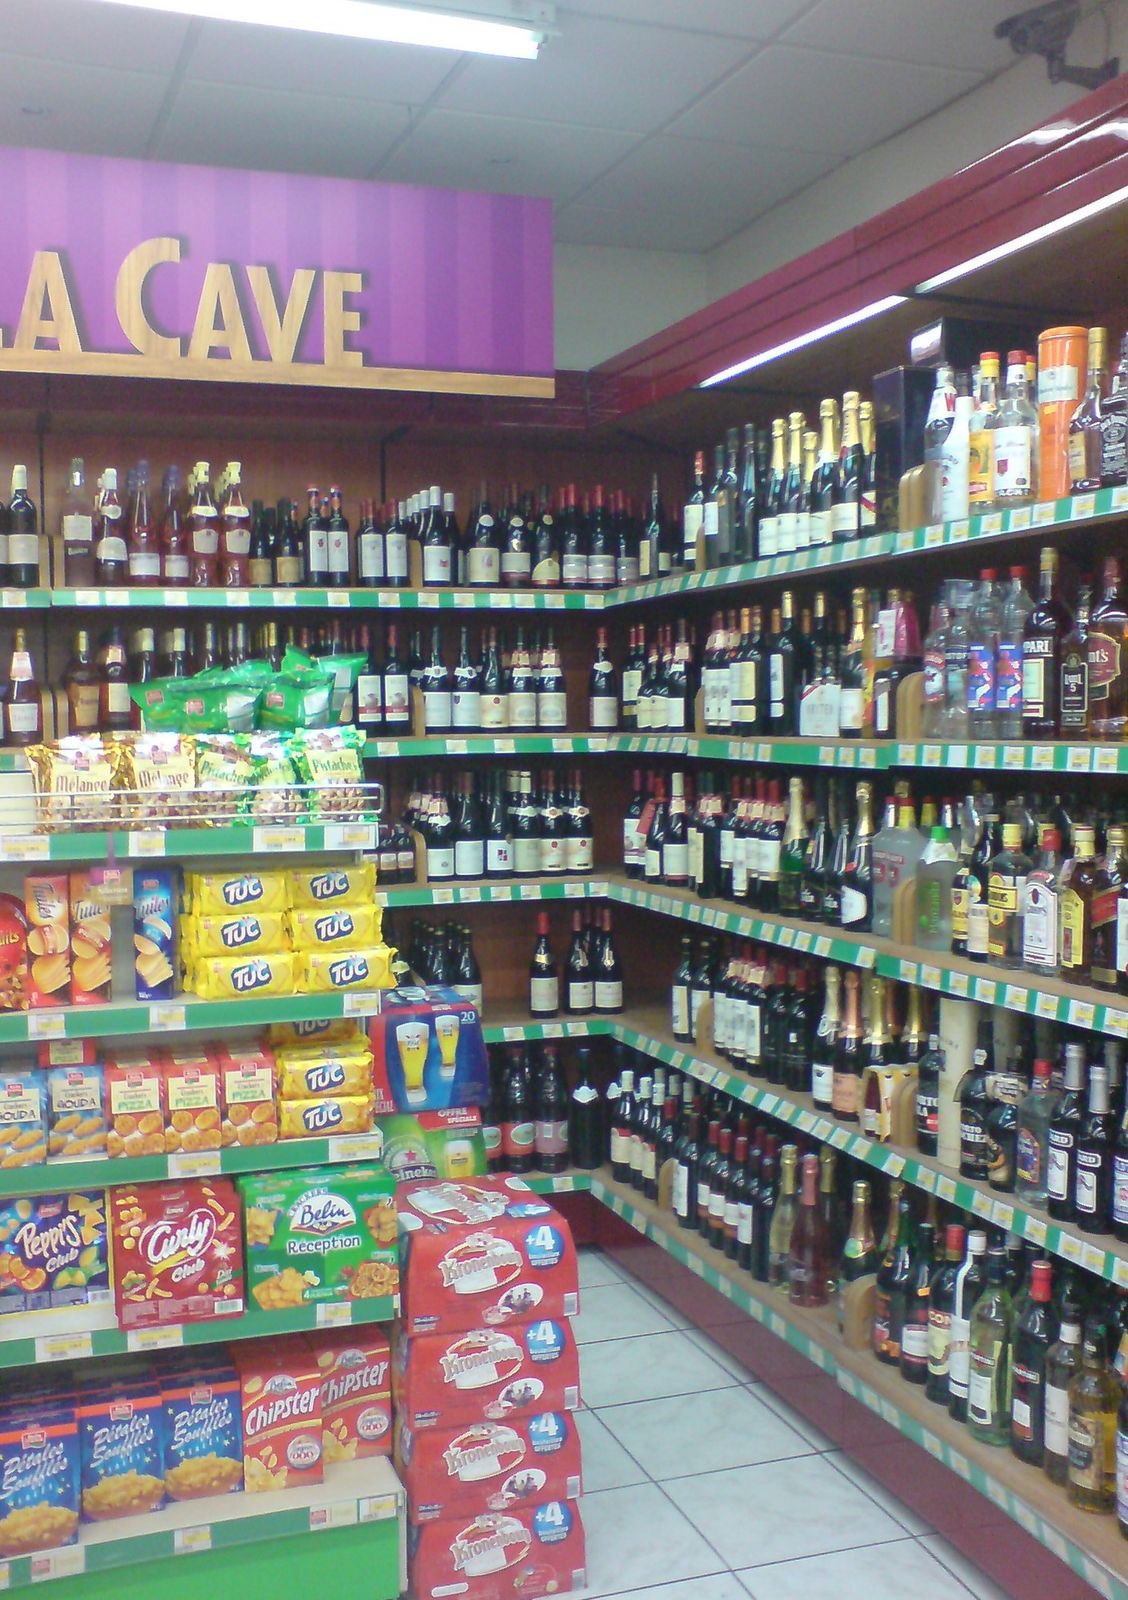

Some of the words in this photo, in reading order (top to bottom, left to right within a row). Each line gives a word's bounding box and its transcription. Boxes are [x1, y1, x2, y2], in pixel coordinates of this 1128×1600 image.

[0, 251, 82, 352] A
[115, 236, 363, 367] CAVE
[1023, 639, 1049, 653] PARI
[1070, 683, 1077, 693] 5
[225, 878, 263, 904] TUC
[313, 874, 350, 899] TUC
[223, 920, 260, 946] TUC
[316, 916, 354, 940] TUC
[233, 963, 271, 990] TUC
[331, 959, 368, 985] TUC
[461, 1011, 475, 1022] 20
[307, 1066, 343, 1090] TUC
[305, 1104, 340, 1129] TUC
[301, 1200, 350, 1226] Belin
[147, 1212, 211, 1264] Curly
[525, 1225, 556, 1250] +4
[171, 1258, 206, 1283] Club
[526, 1320, 557, 1345] +4
[529, 1411, 559, 1436] +4
[535, 1501, 565, 1526] +4
